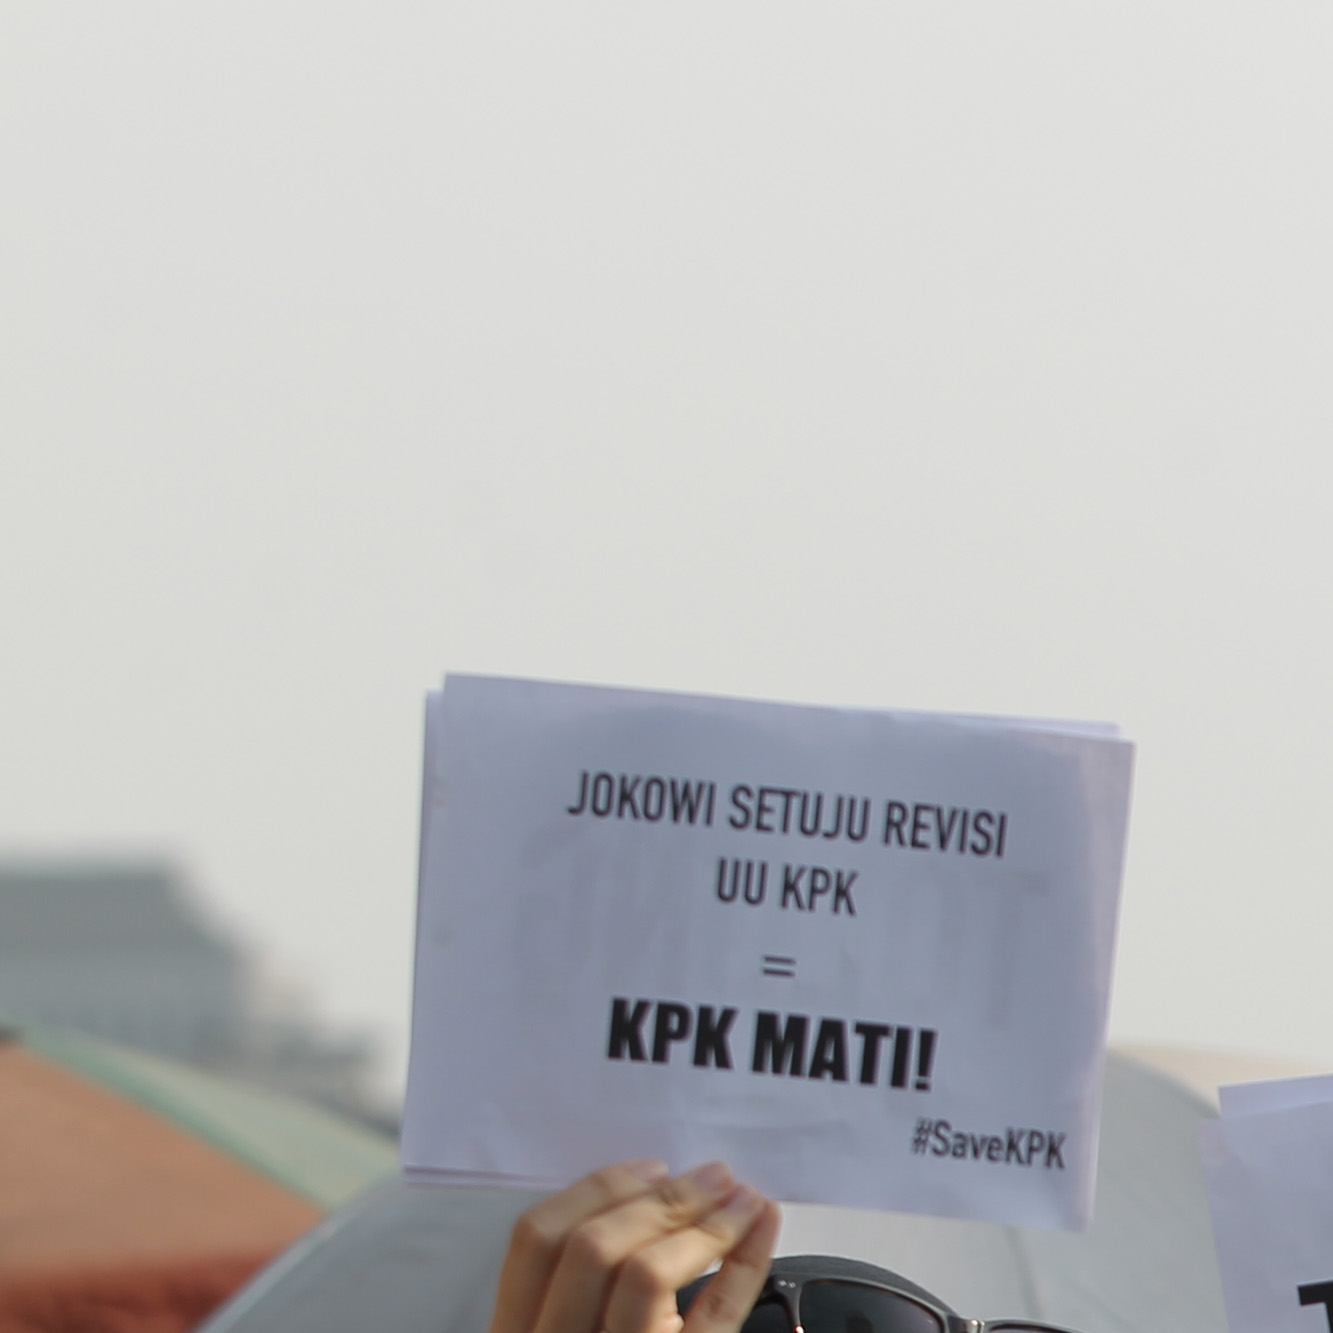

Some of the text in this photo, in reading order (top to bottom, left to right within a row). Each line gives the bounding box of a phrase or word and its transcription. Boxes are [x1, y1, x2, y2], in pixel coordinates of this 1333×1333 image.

[567, 771, 1007, 858] JOKOWI SETUJU REVISI
[716, 857, 858, 916] UU KPK
[762, 955, 796, 978] =
[606, 997, 938, 1093] KPK MATI!
[911, 1119, 1067, 1171] #SaveKPK
